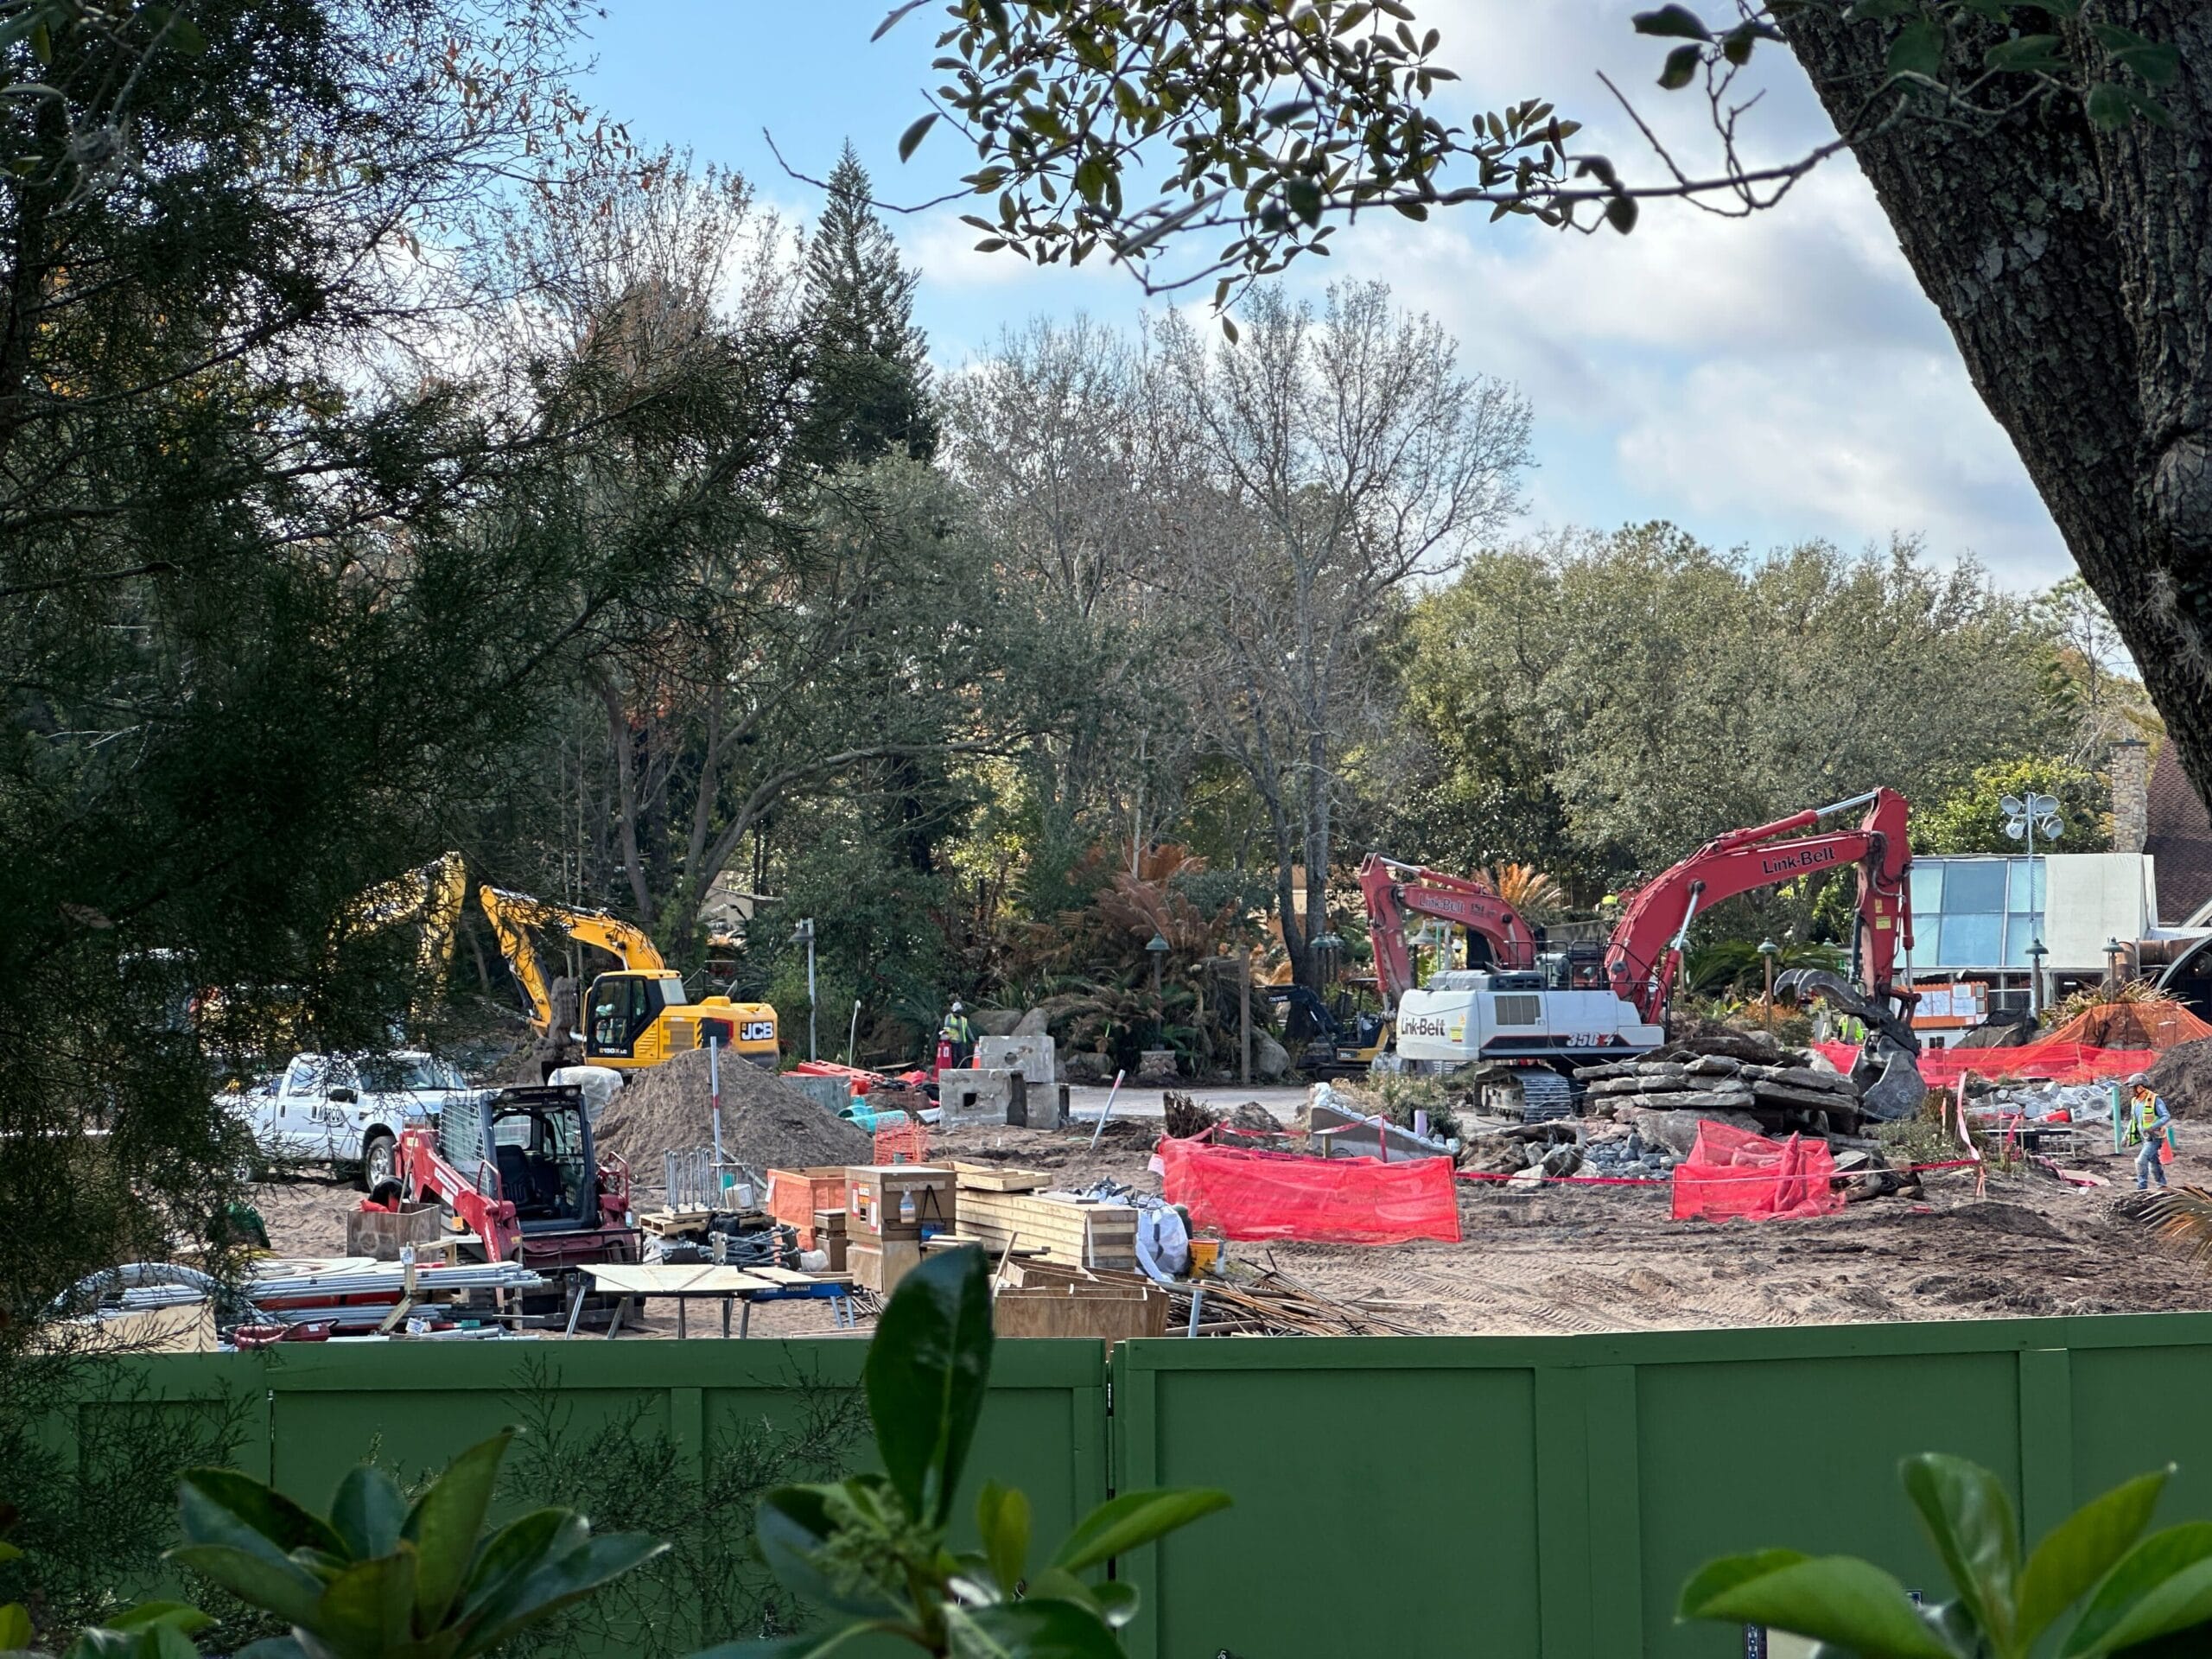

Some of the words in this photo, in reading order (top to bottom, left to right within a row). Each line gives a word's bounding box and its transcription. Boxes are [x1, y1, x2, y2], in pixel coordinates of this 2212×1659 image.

[1763, 846, 1835, 874] Link-Belt
[1419, 893, 1465, 914] Link-Belt
[741, 1021, 773, 1040] JCB
[1401, 1017, 1446, 1036] Link-Belt
